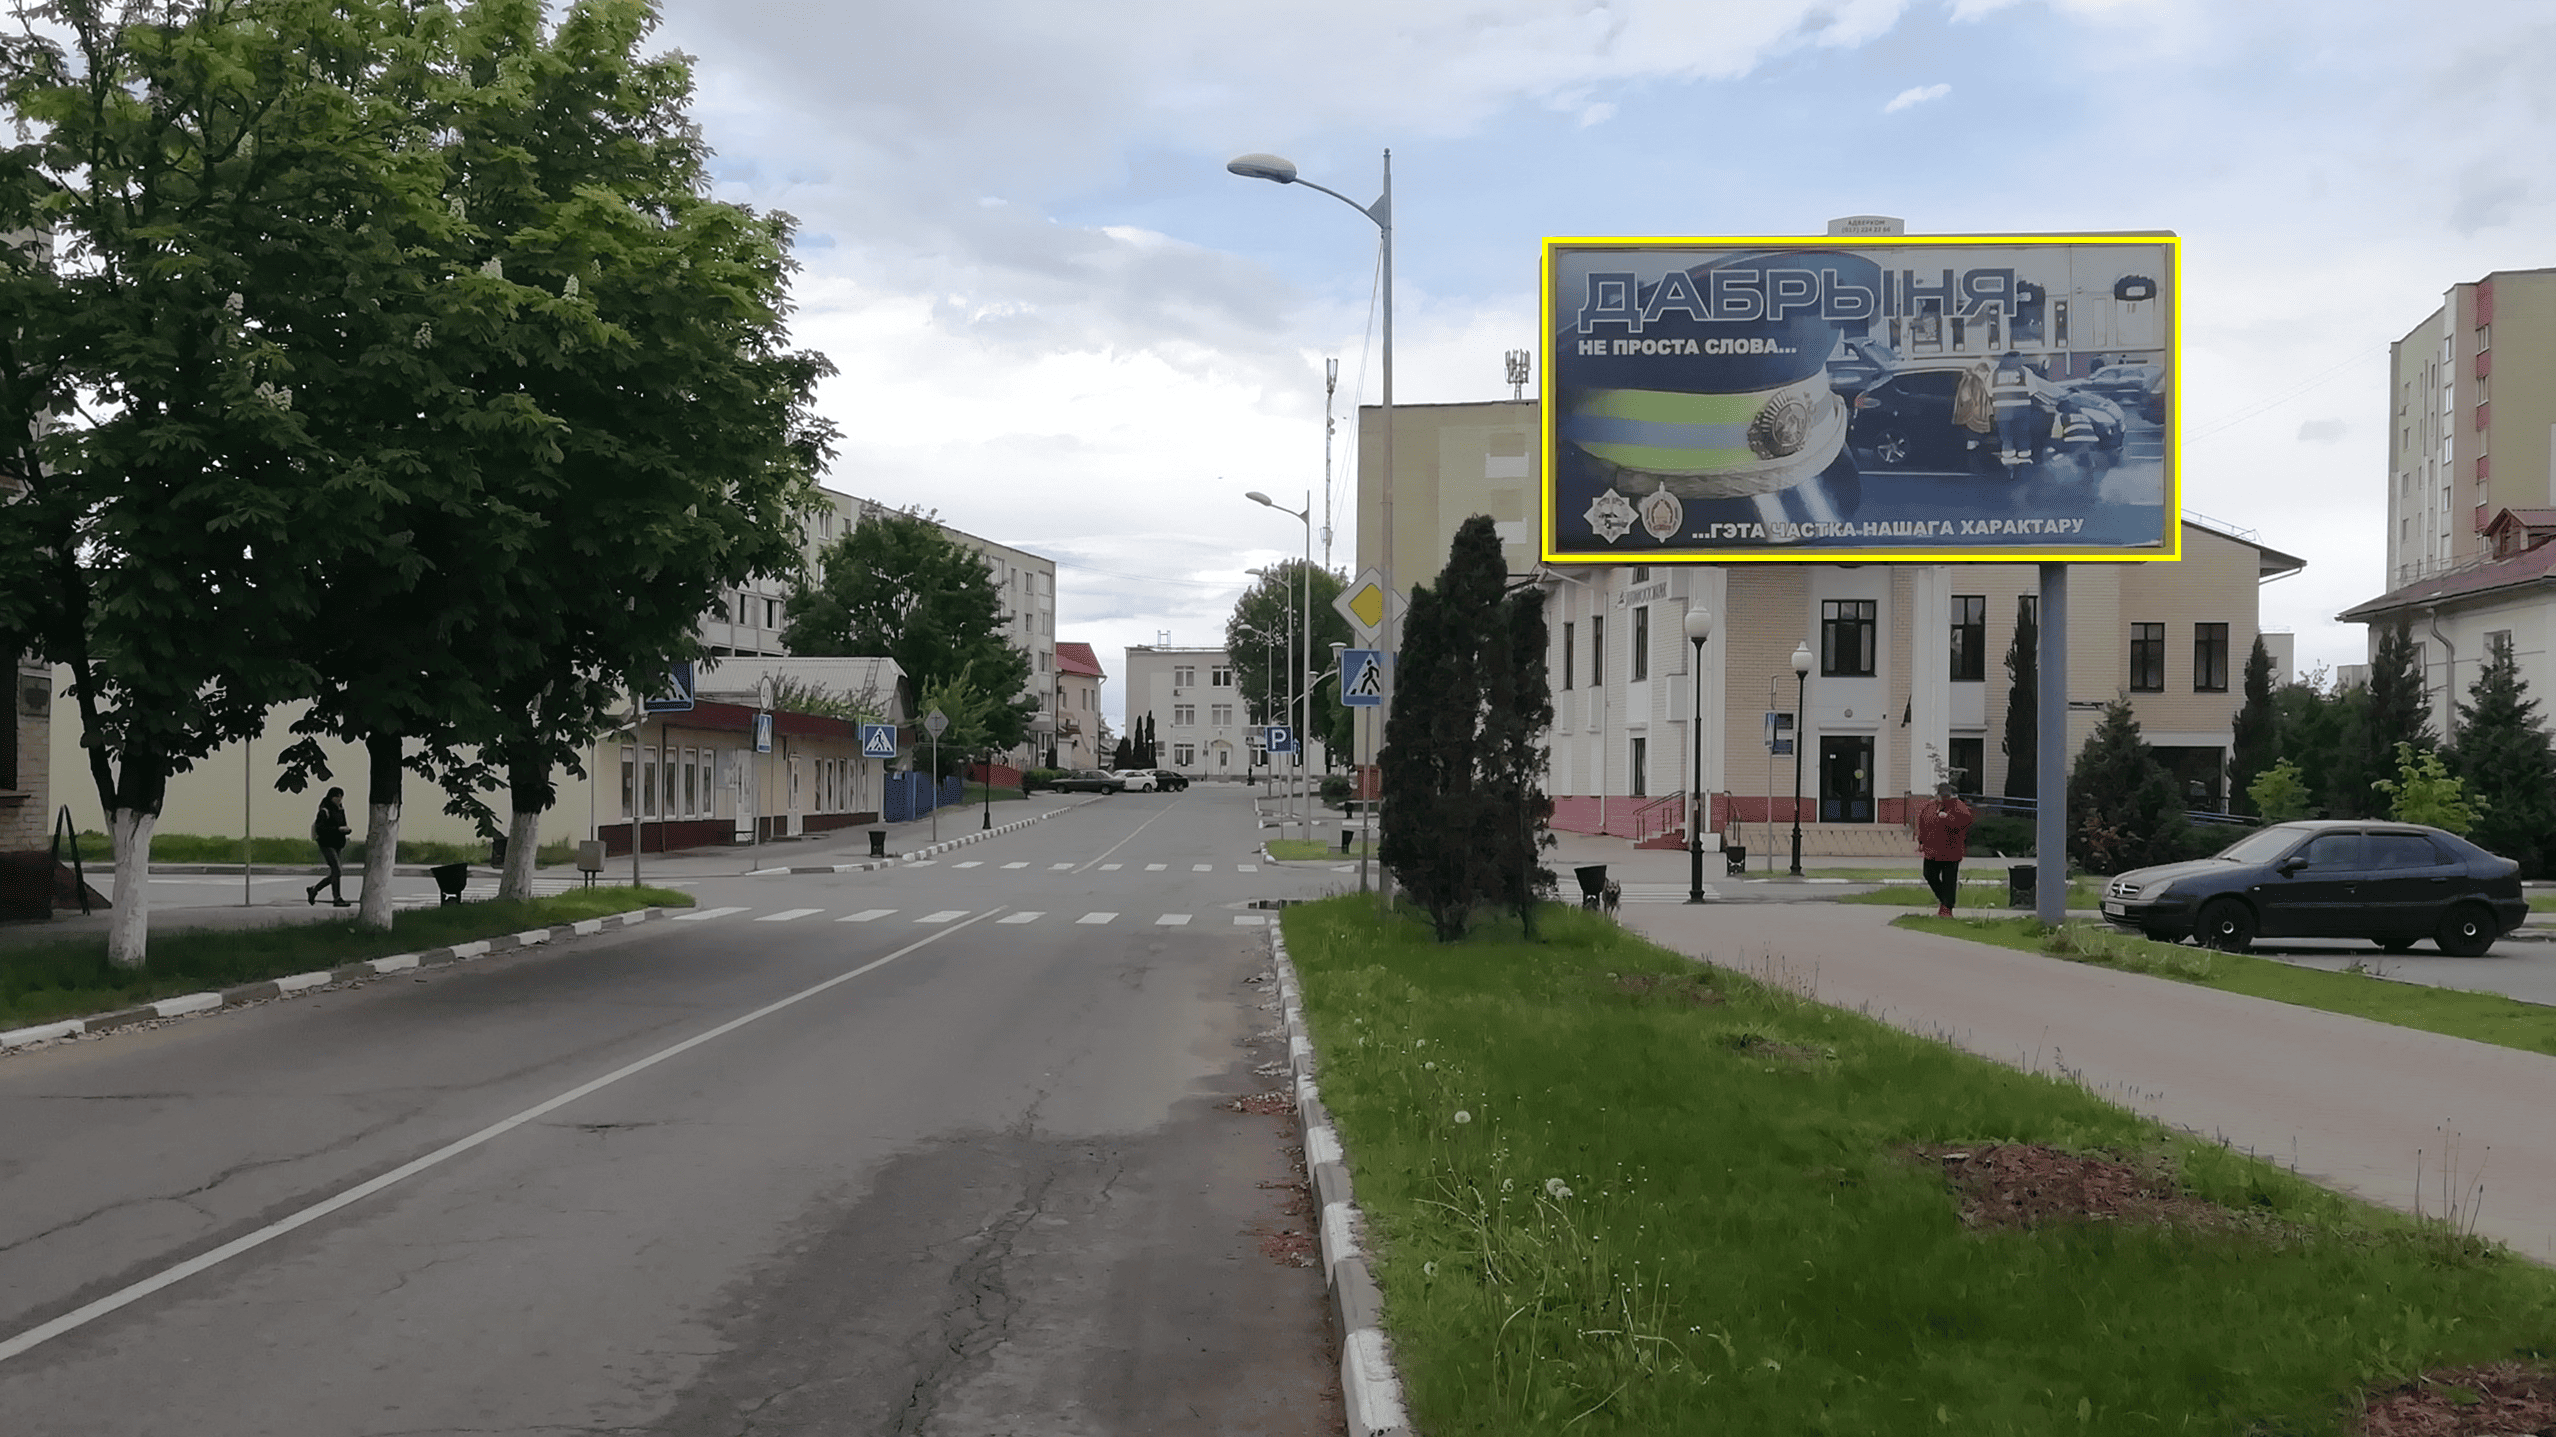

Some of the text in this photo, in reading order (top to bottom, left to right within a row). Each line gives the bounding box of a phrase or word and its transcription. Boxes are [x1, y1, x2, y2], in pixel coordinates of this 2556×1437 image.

[1577, 267, 2018, 334] ДАБРЫНЯ
[1578, 337, 1797, 355] НЕ ПРОСТА СЛОВА...
[1691, 518, 2084, 539] ...ГЭТА ЧАСТКА НАШАГА ХАРАКТАРУ
[1272, 729, 1287, 750] P
